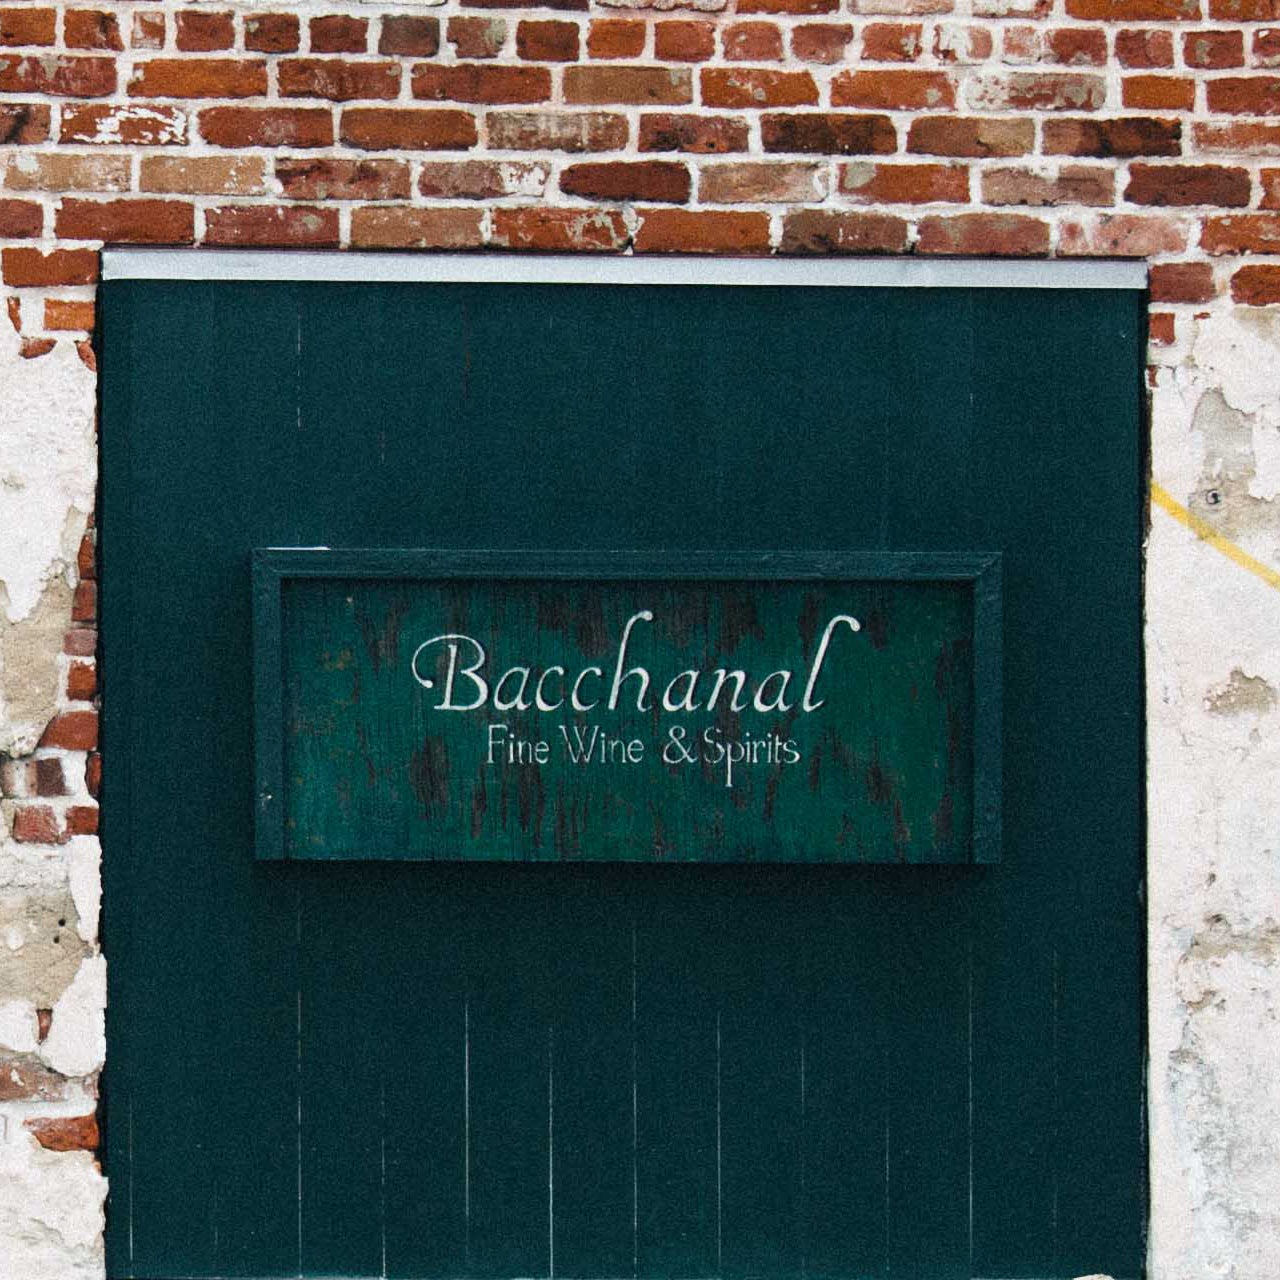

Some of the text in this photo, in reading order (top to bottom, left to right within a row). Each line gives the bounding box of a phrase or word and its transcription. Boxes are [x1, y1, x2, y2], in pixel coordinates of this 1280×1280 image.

[411, 610, 861, 713] Bacchanal
[486, 724, 802, 787] Fine Wine & Spirits
